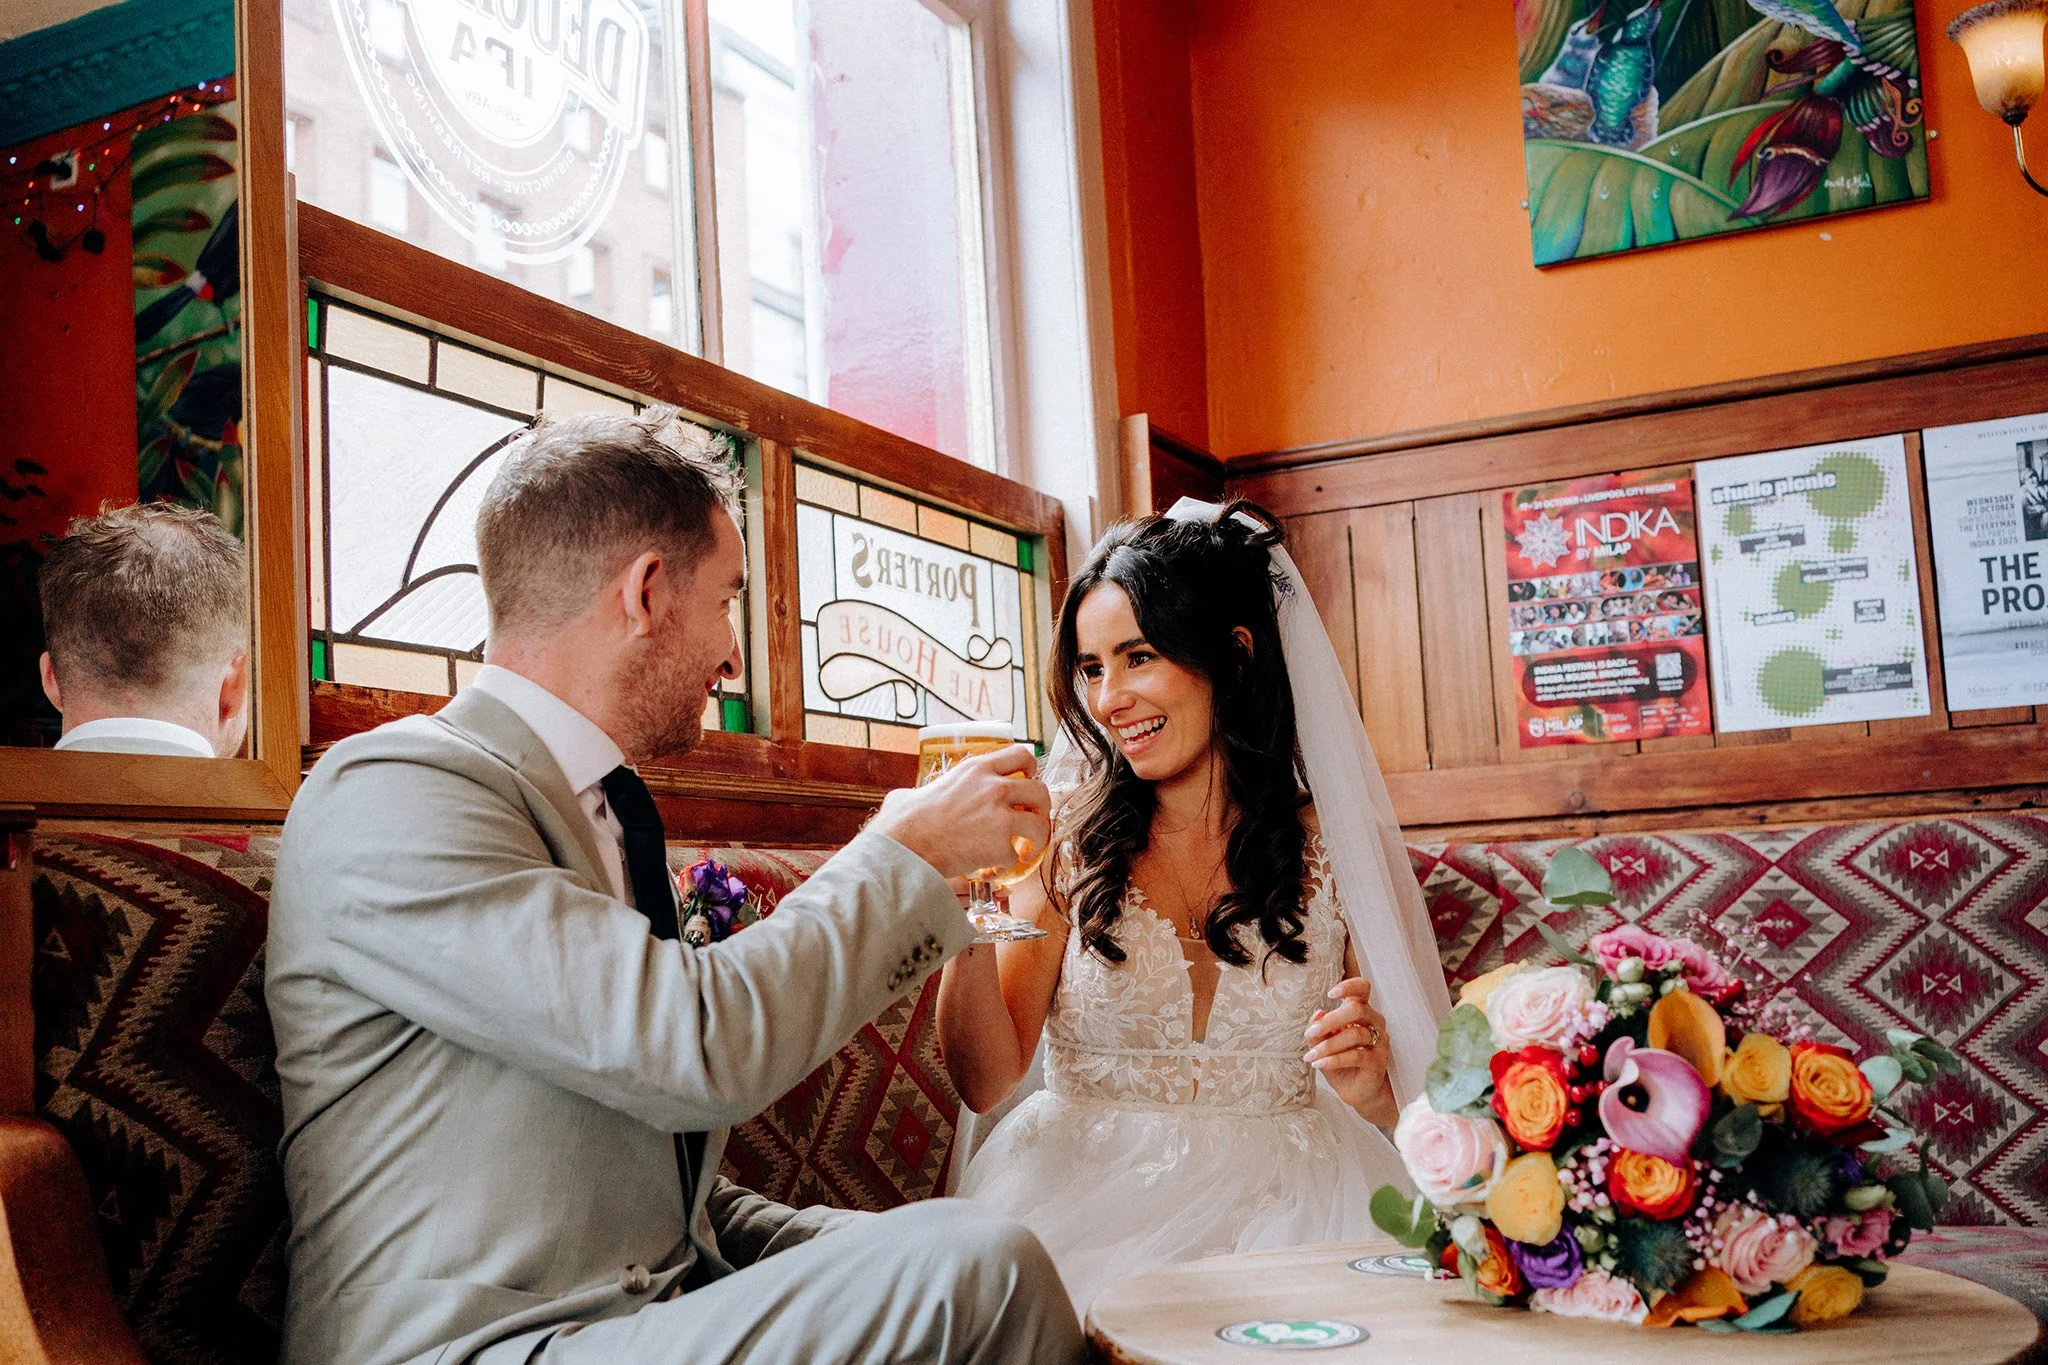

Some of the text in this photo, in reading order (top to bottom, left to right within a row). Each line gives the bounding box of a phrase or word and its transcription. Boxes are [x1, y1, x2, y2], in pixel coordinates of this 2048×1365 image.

[1575, 506, 1681, 547] INDIKA
[1980, 552, 2041, 583] THE
[1982, 584, 2048, 615] PRO
